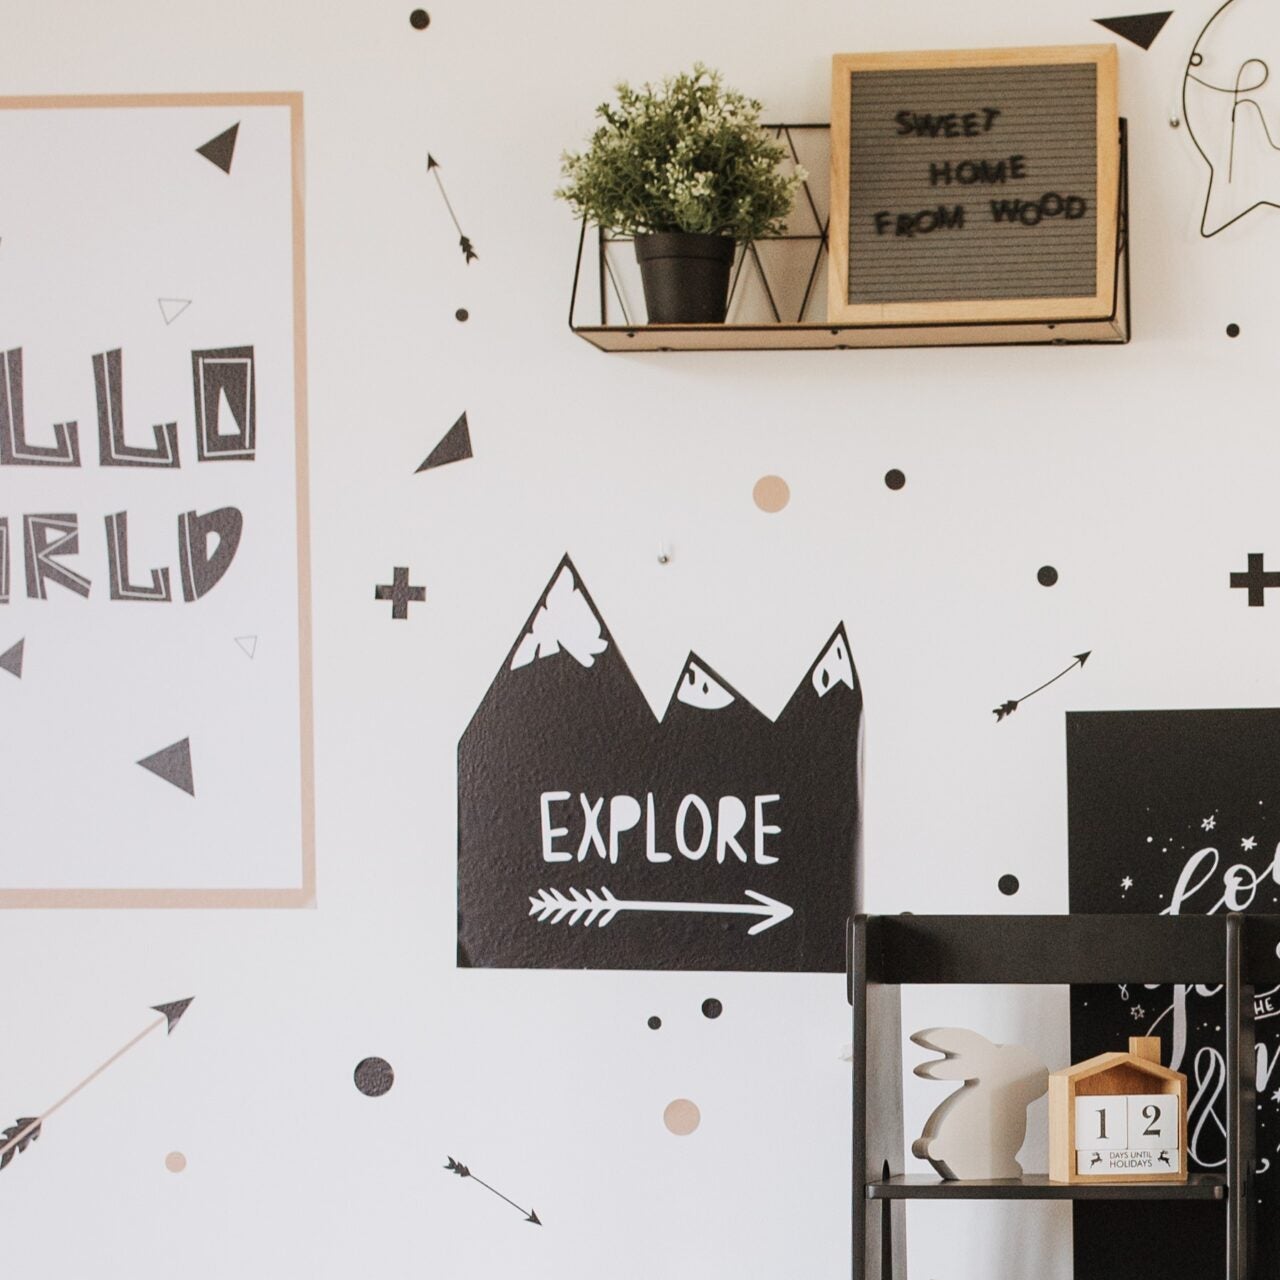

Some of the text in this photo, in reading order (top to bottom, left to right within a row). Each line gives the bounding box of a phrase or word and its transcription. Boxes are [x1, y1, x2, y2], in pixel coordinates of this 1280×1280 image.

[895, 107, 1000, 138] SWEET
[929, 155, 1027, 186] HOME
[873, 192, 1088, 238] FROM WOOD
[0, 506, 244, 604] RLD
[540, 790, 782, 865] EXPLORE
[1253, 999, 1275, 1016] HE
[1109, 1151, 1129, 1159] DAYS
[1109, 1159, 1153, 1168] HOLIDAYS
